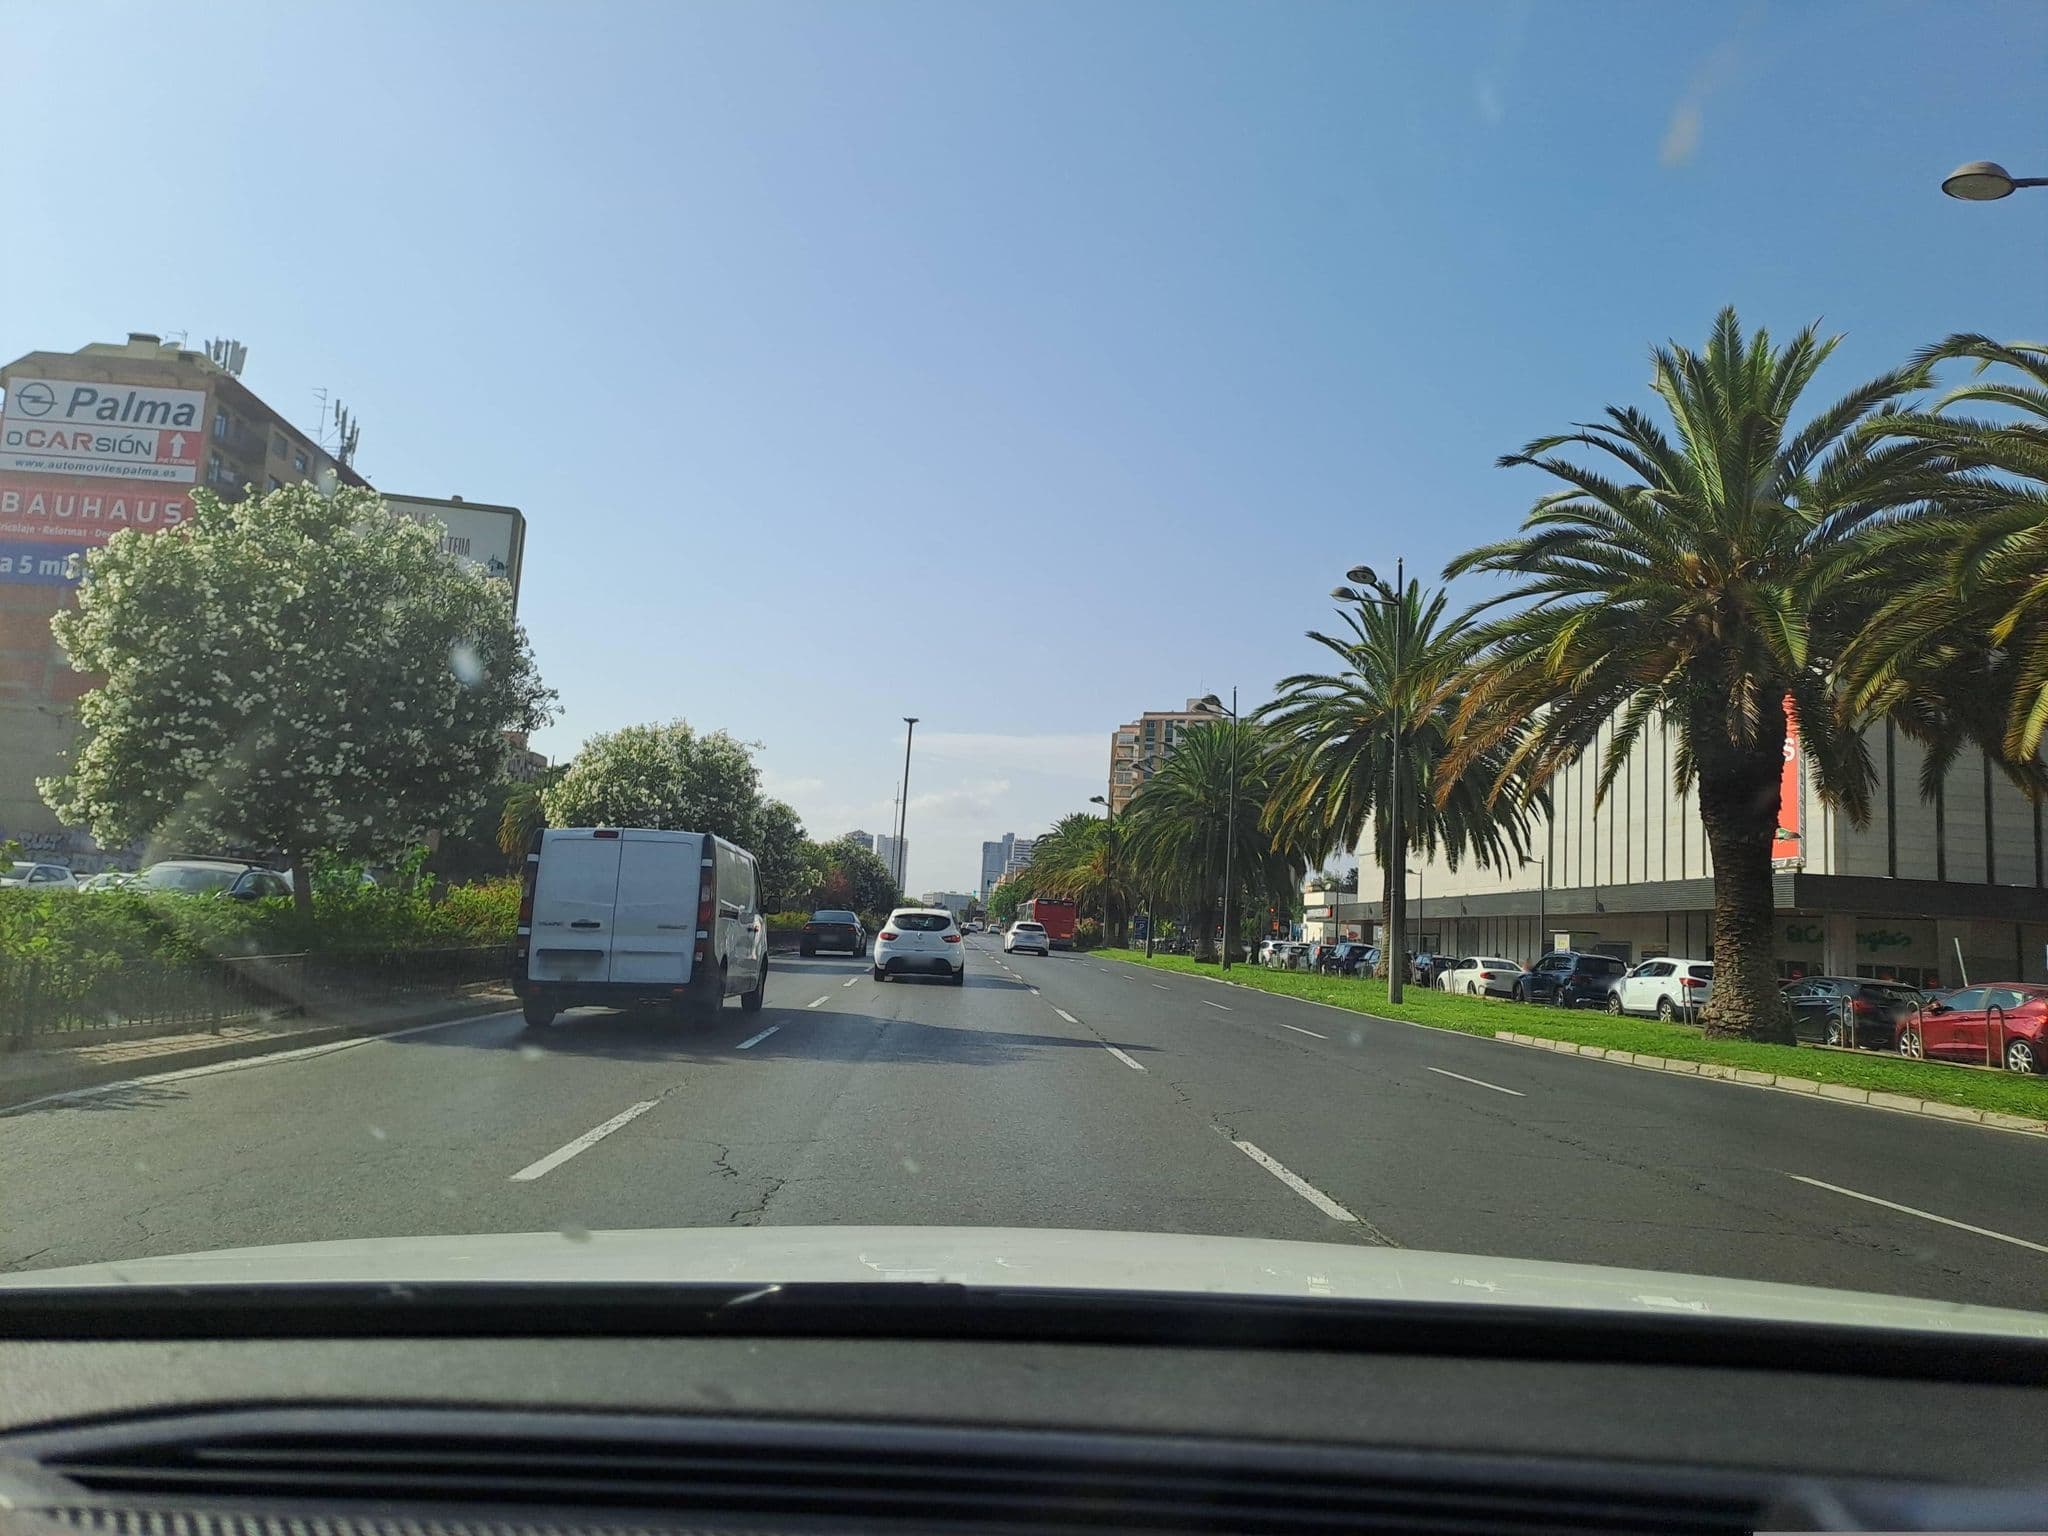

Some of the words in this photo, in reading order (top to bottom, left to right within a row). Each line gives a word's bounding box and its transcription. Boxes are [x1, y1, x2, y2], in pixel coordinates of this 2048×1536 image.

[66, 387, 196, 426] Palma
[15, 459, 177, 478] www.automovilespalma.es
[1, 491, 182, 524] BAUHAUS
[18, 555, 33, 575] 5
